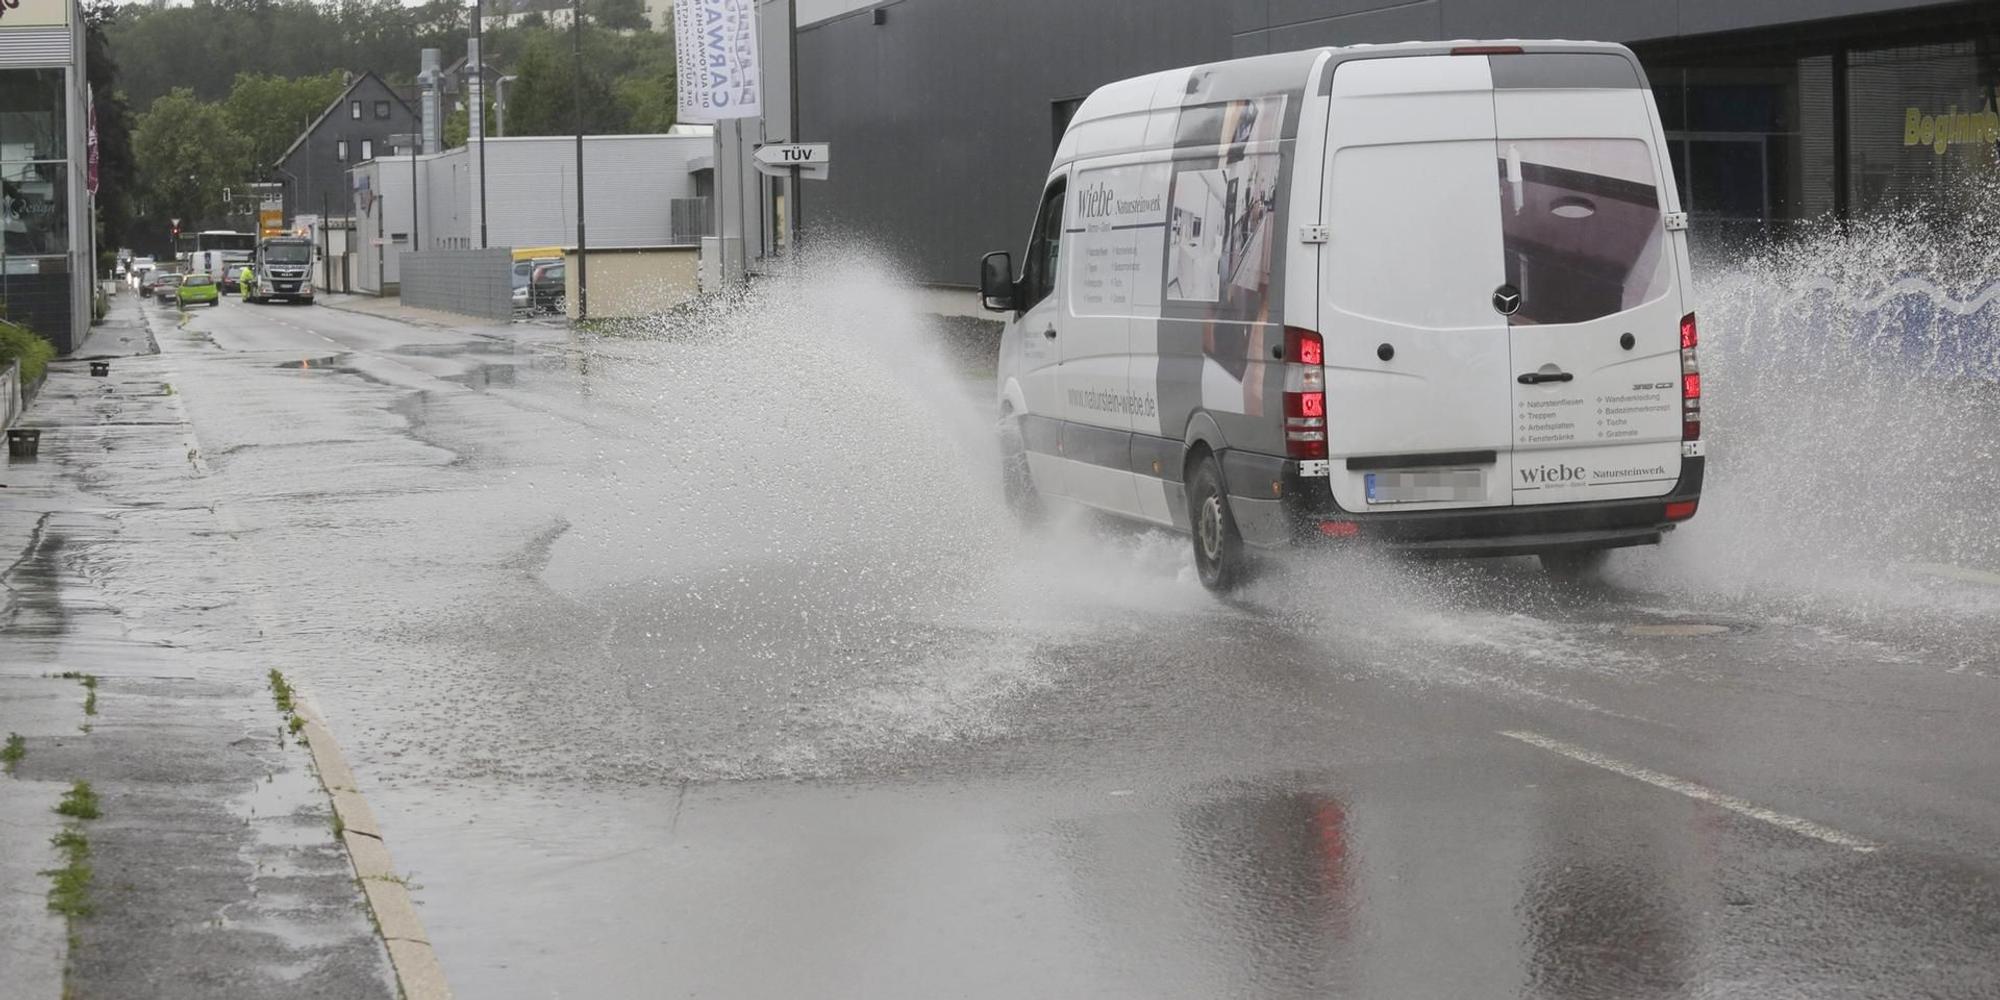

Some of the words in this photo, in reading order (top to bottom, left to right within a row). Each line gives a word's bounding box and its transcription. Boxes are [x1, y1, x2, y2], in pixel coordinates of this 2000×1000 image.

[782, 146, 813, 161] TÜV
[1078, 181, 1114, 219] wiebe
[1067, 386, 1155, 417] www.naturstein-wiebe.de
[1527, 412, 1557, 420] Treppen
[1528, 422, 1575, 431] Arbeitsplatten
[1528, 433, 1575, 443] Fensterbänke
[1520, 464, 1586, 483] wiebe
[1592, 465, 1666, 479] Natursteinwerk
